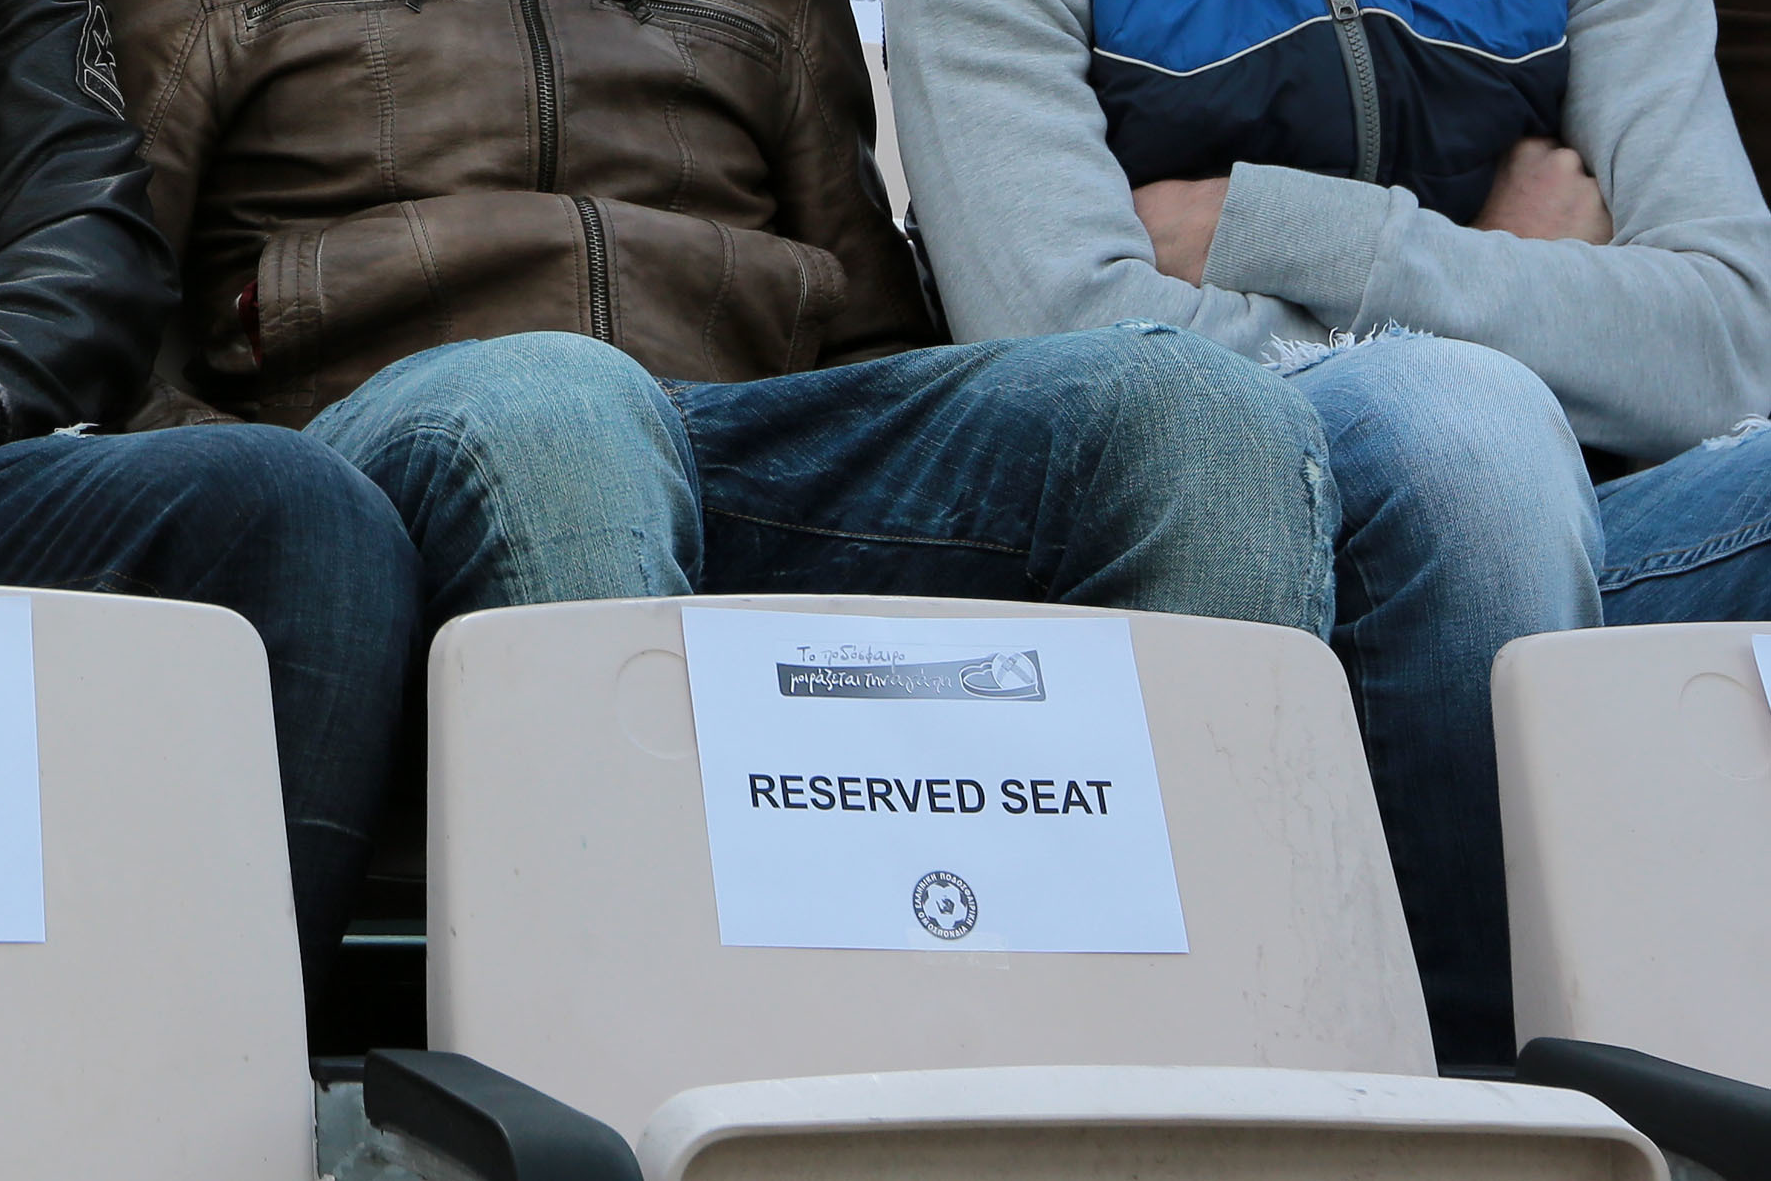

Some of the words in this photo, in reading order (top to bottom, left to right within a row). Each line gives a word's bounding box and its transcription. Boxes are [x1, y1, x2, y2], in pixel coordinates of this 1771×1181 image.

[797, 646, 816, 662] Το
[790, 668, 861, 695] μοιράζεται
[865, 672, 889, 690] την
[748, 773, 986, 814] RESERVED
[1000, 779, 1112, 815] SEAT
